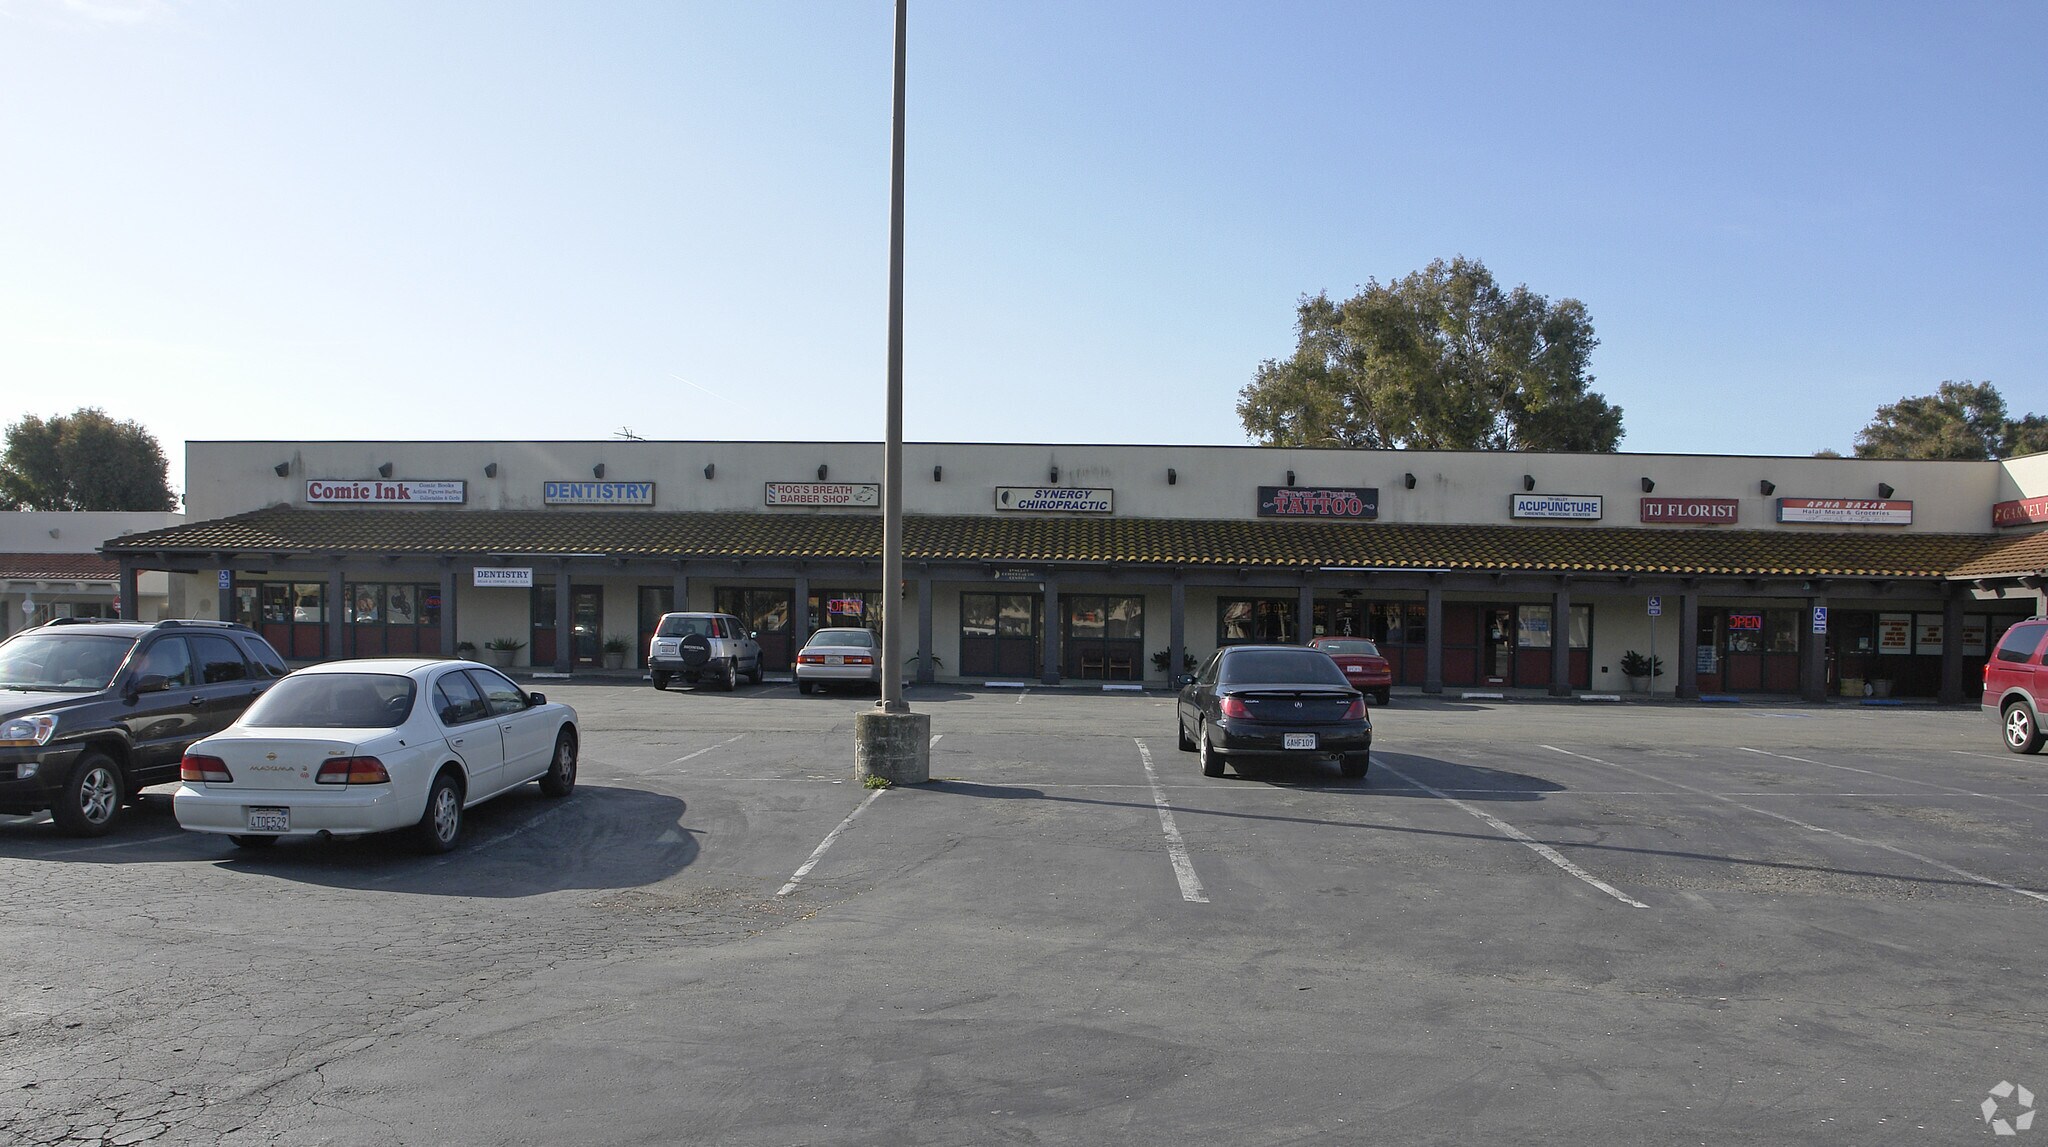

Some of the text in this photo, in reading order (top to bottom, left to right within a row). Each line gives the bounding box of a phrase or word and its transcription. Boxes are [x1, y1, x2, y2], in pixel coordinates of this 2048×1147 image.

[308, 482, 411, 500] Comic Ink
[546, 483, 651, 499] DENTISTRY
[777, 485, 853, 495] HOG'S BREATH
[1034, 490, 1093, 500] SYNERGY
[780, 495, 850, 503] BARBER SHOP
[1018, 500, 1108, 510] CHIROPRACTIC
[1273, 497, 1363, 516] TATTOO
[1518, 501, 1598, 512] ACUPUNCTURE
[1646, 503, 1737, 517] TJ FLORIST
[1845, 501, 1888, 510] BAZAR
[477, 570, 529, 579] DENTISTRY
[831, 601, 861, 612] OPEN
[1729, 616, 1761, 628] OPEN
